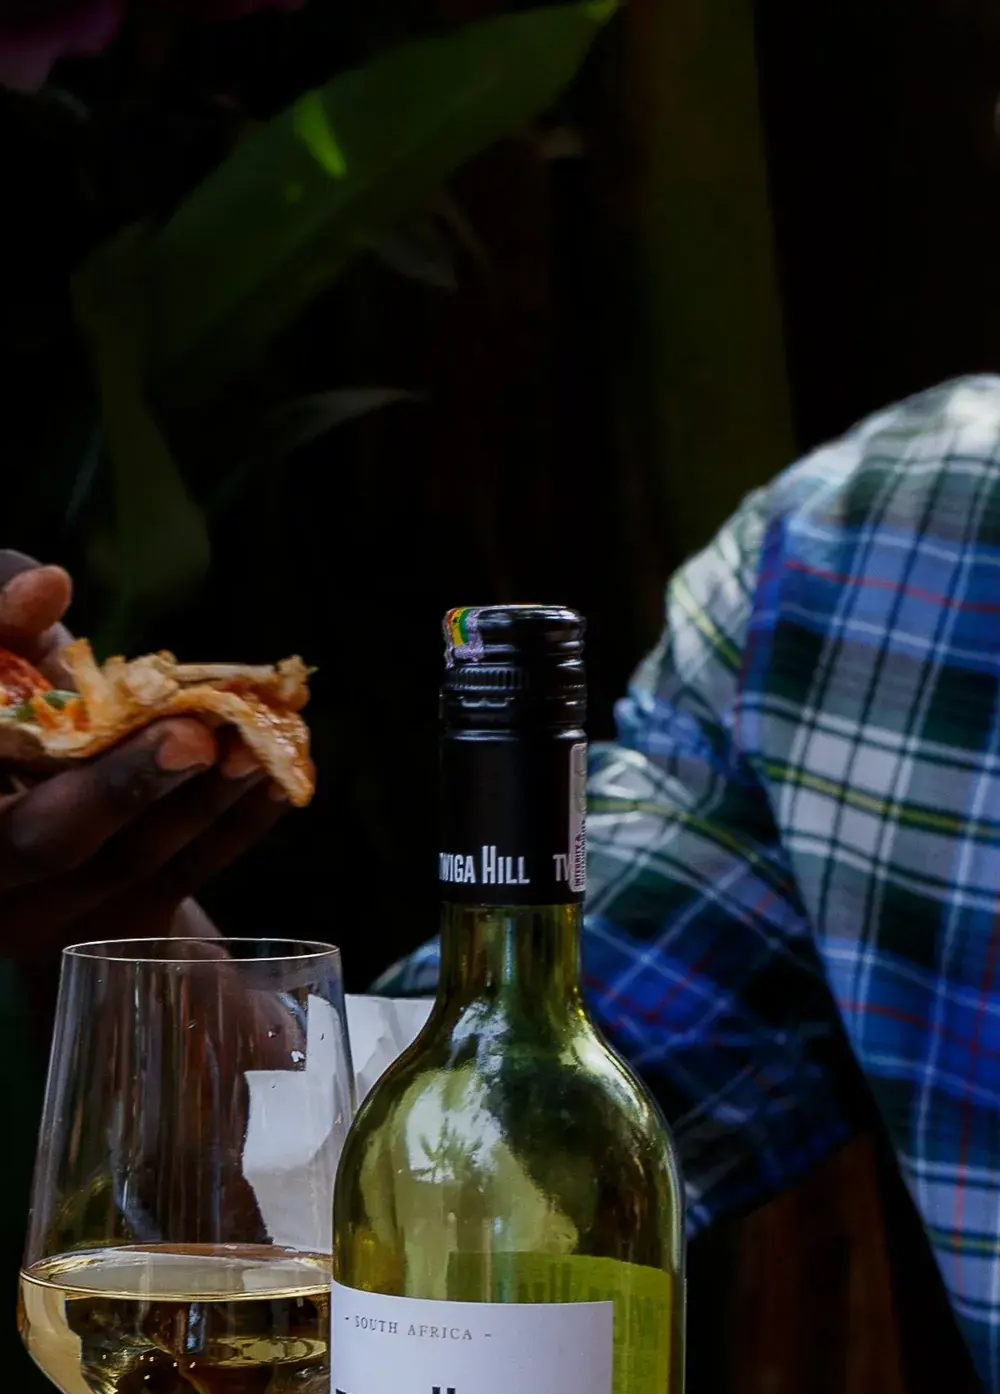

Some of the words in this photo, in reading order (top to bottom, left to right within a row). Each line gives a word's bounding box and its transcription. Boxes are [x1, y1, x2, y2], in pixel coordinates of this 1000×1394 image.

[482, 845, 531, 884] HILL
[354, 1315, 399, 1334] SOUTH
[407, 1324, 473, 1341] AFRICA
